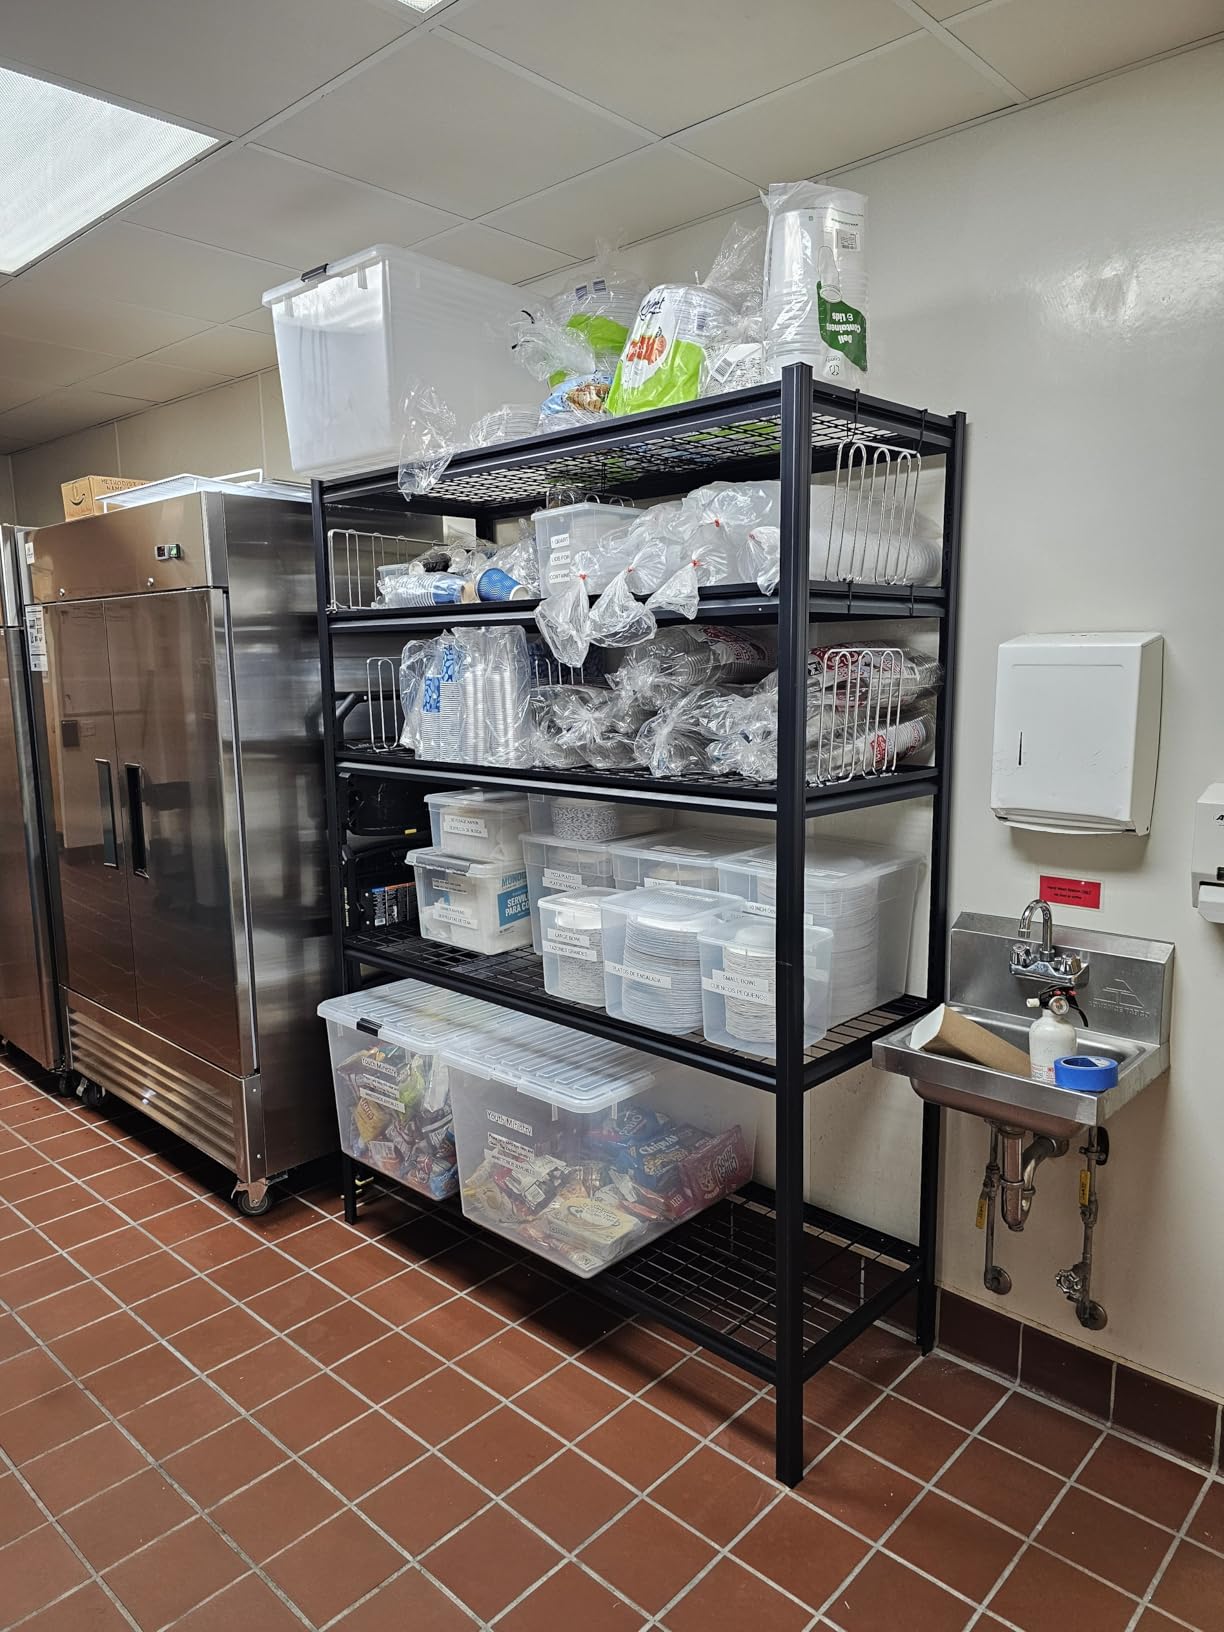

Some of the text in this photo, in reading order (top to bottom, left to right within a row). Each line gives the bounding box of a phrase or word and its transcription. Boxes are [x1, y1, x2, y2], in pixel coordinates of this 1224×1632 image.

[831, 312, 847, 322] Lids
[826, 322, 861, 334] Containers
[505, 902, 522, 917] PARA
[722, 974, 741, 985] SMALL
[487, 1111, 532, 1136] Youth Ministry
